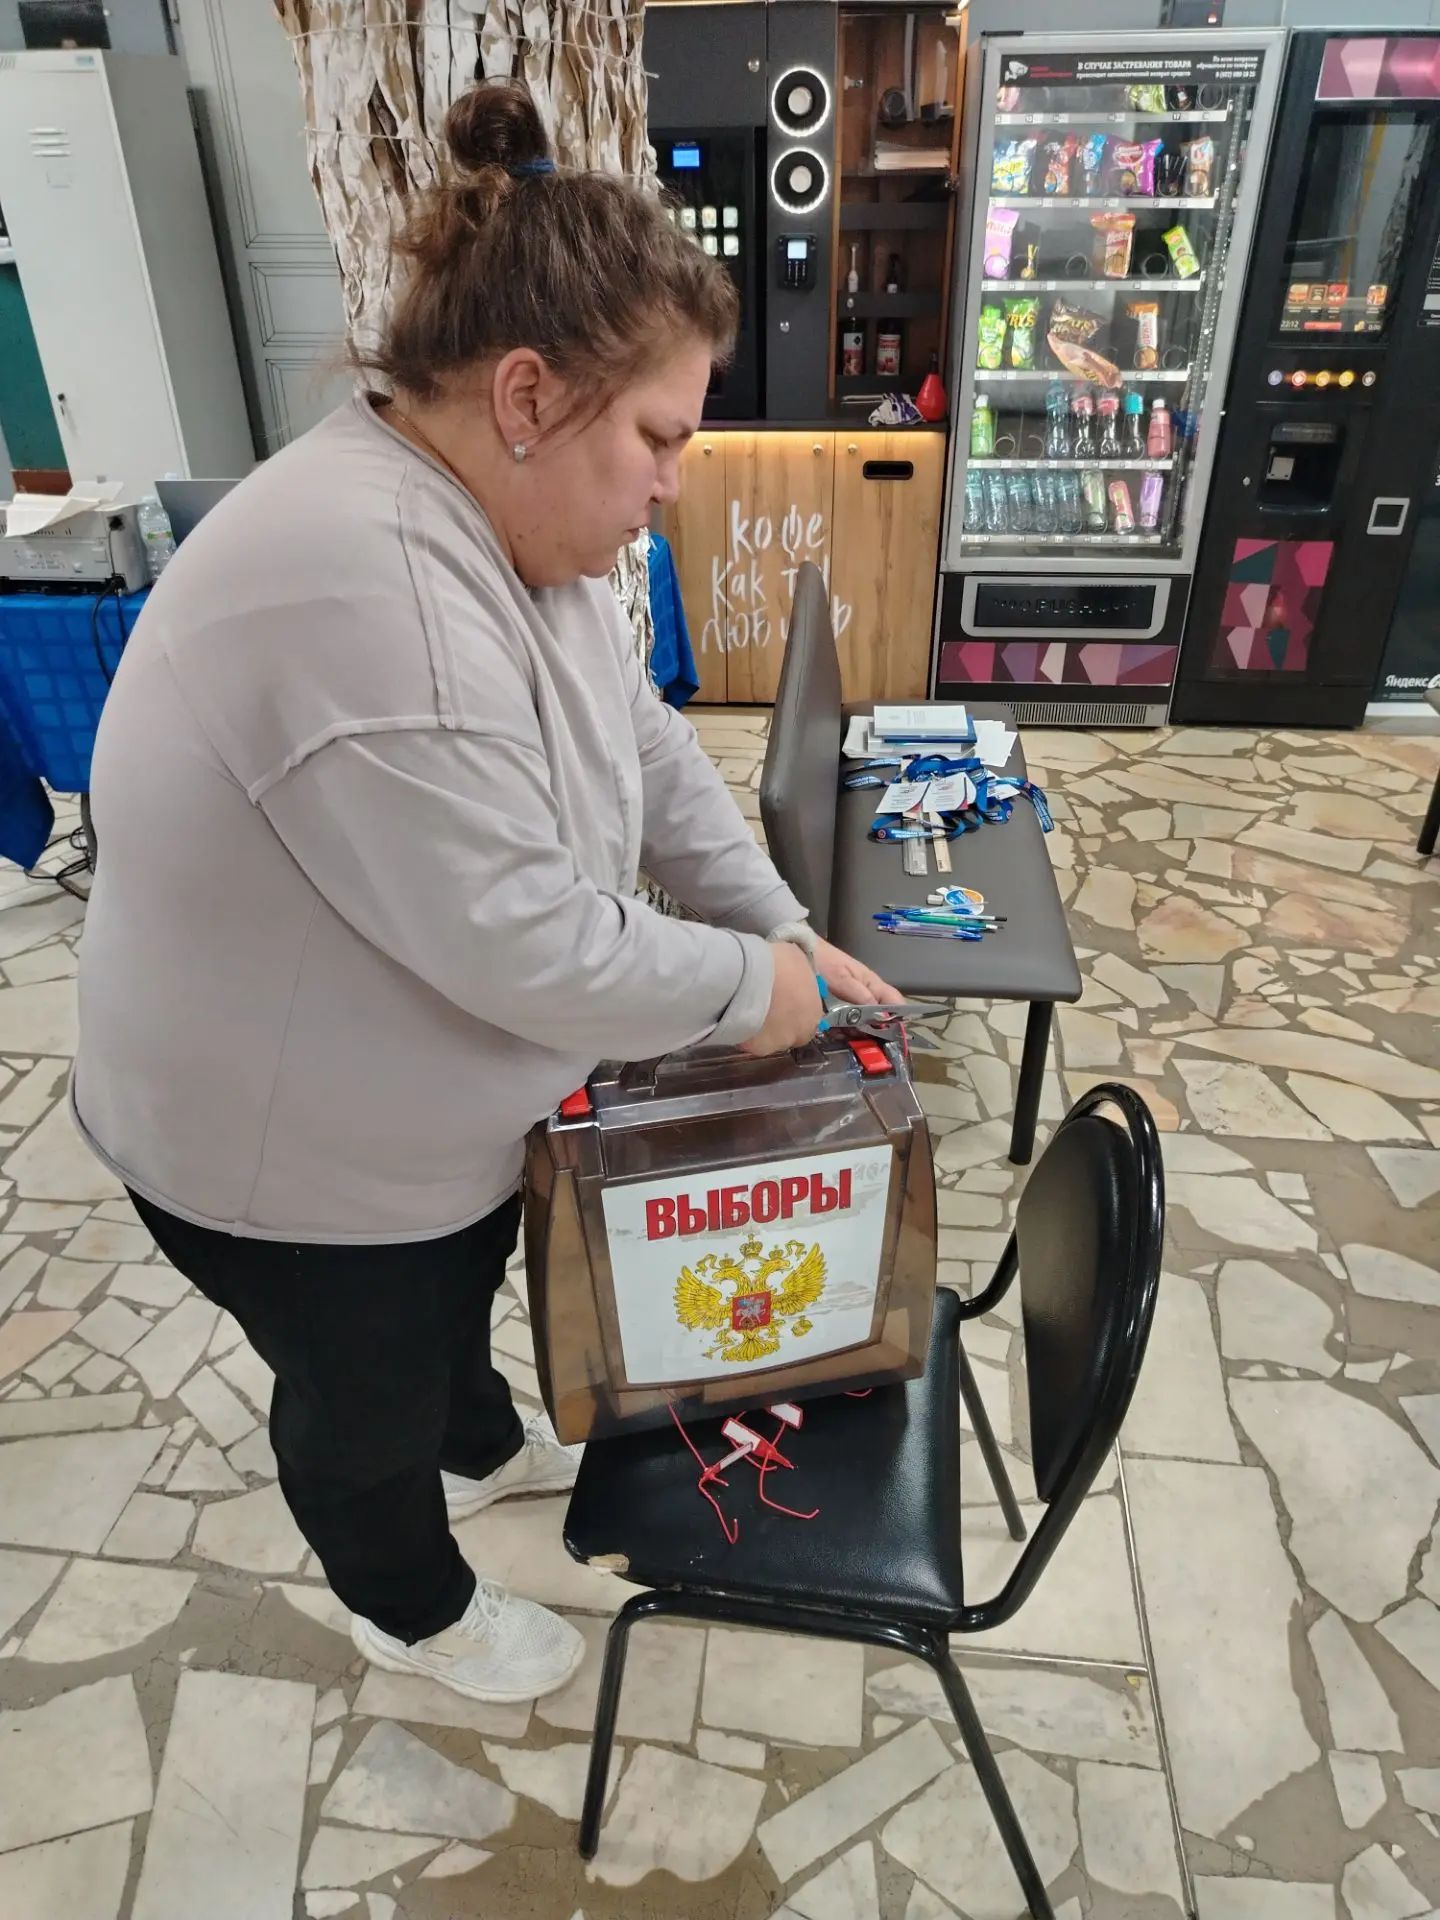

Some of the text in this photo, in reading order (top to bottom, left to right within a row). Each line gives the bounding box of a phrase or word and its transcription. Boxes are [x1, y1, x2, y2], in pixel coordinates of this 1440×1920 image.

[1084, 61, 1112, 70] СЛУЧАЕ
[1165, 60, 1191, 69] ТОВАРА
[1385, 675, 1429, 688] Яндекс
[646, 1168, 852, 1241] ВЫБОРЫ
